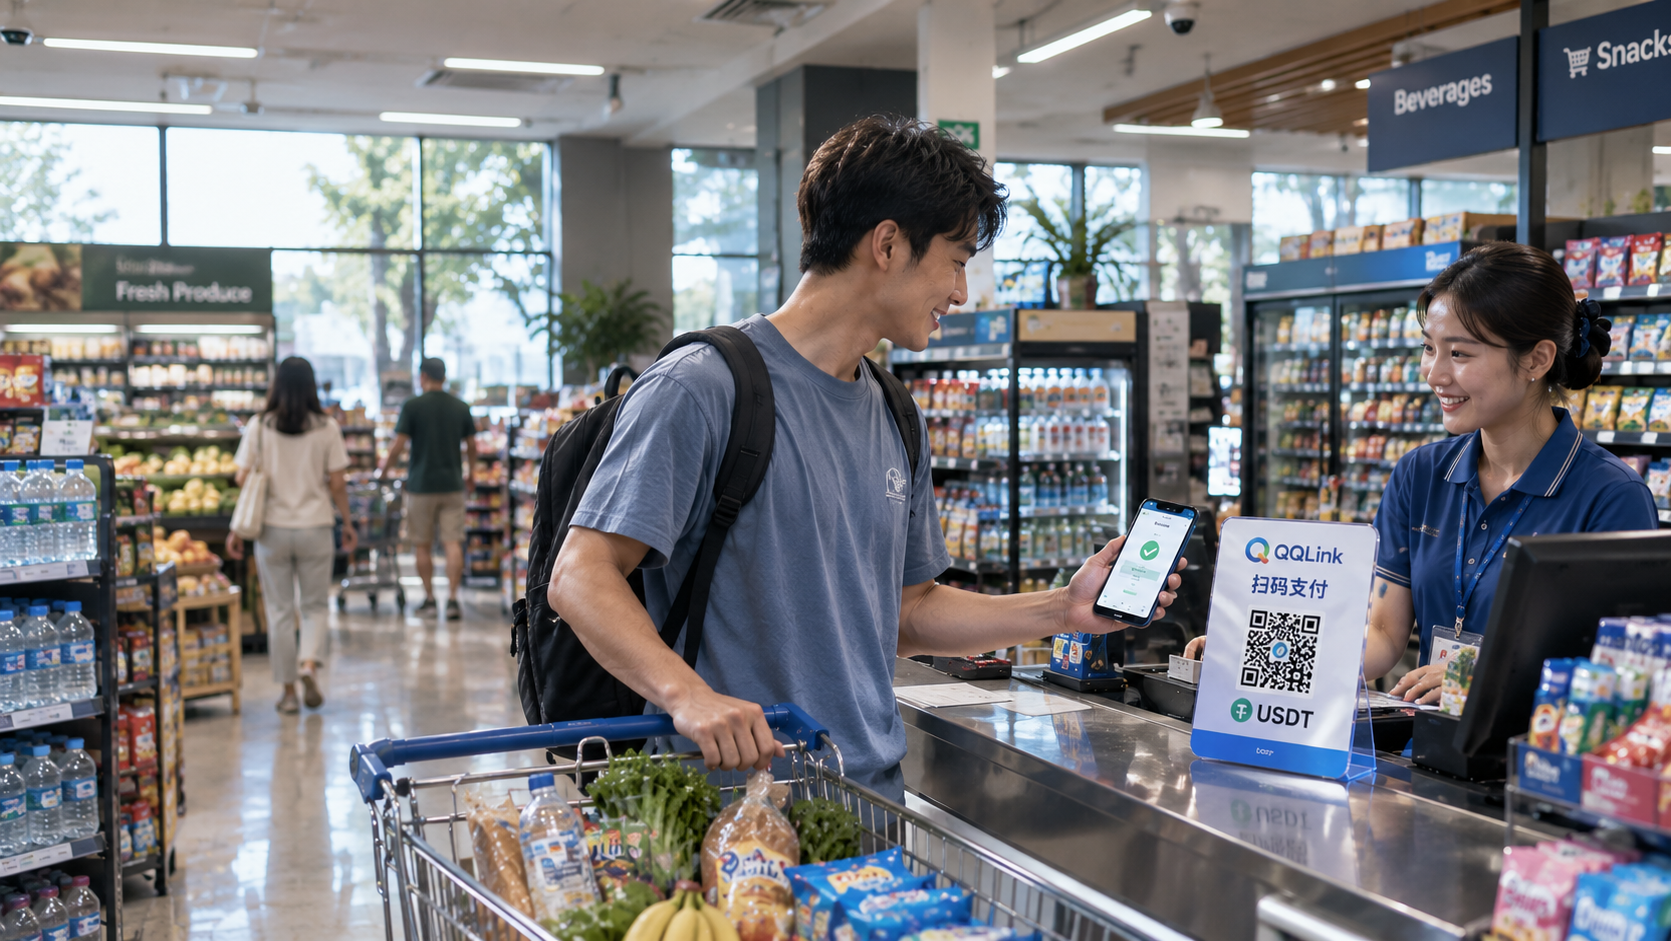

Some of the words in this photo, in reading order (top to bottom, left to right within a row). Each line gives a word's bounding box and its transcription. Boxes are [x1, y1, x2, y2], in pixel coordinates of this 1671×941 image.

[1597, 29, 1671, 70] Snack
[1394, 73, 1493, 116] Beverages
[116, 280, 170, 302] Fresh
[172, 281, 253, 303] Produce
[1274, 544, 1343, 564] QQLink
[1251, 574, 1328, 599] 扫码支付
[1257, 704, 1314, 729] USDT
